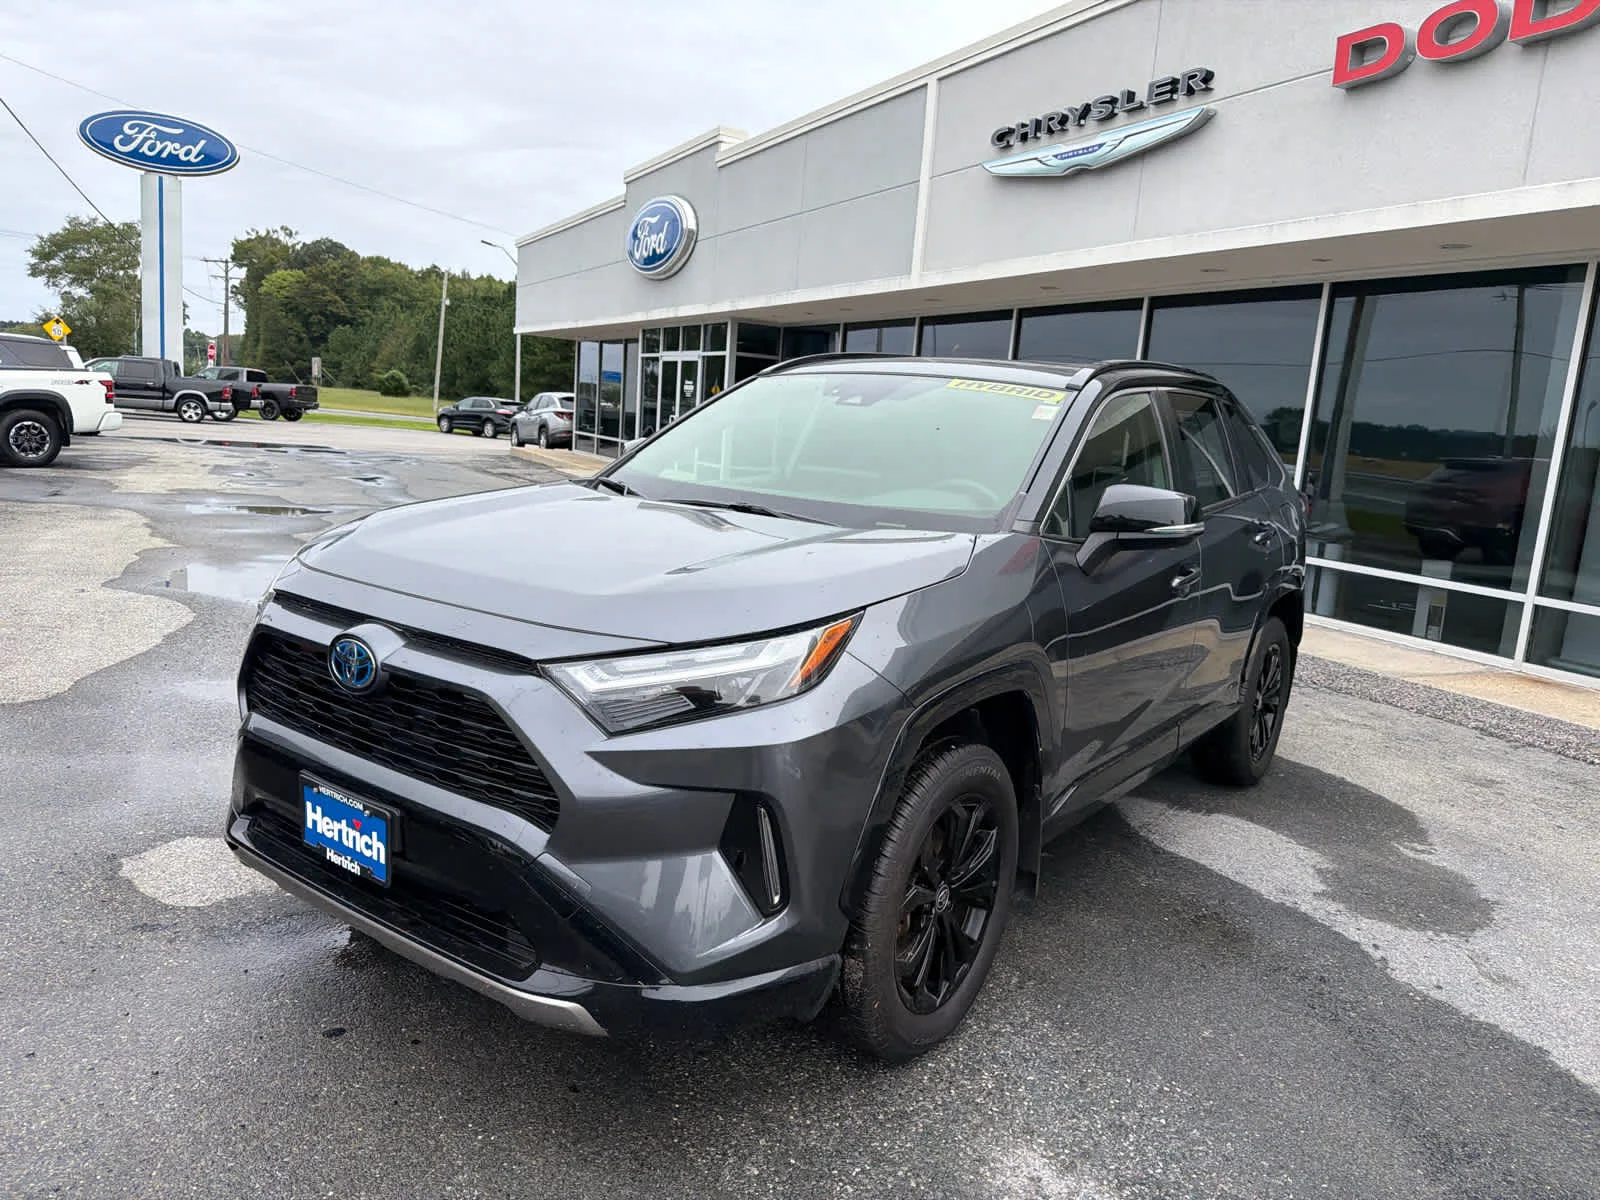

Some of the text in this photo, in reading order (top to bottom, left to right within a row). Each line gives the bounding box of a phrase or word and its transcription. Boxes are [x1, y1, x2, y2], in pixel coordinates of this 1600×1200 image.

[991, 67, 1214, 149] CHRYSLER
[113, 120, 207, 163] Ford
[634, 214, 669, 260] Ford
[955, 381, 1057, 399] HYBRID
[319, 786, 363, 810] HERTRICH.COM
[306, 801, 386, 865] Hertrich
[326, 847, 361, 875] Hertrich
